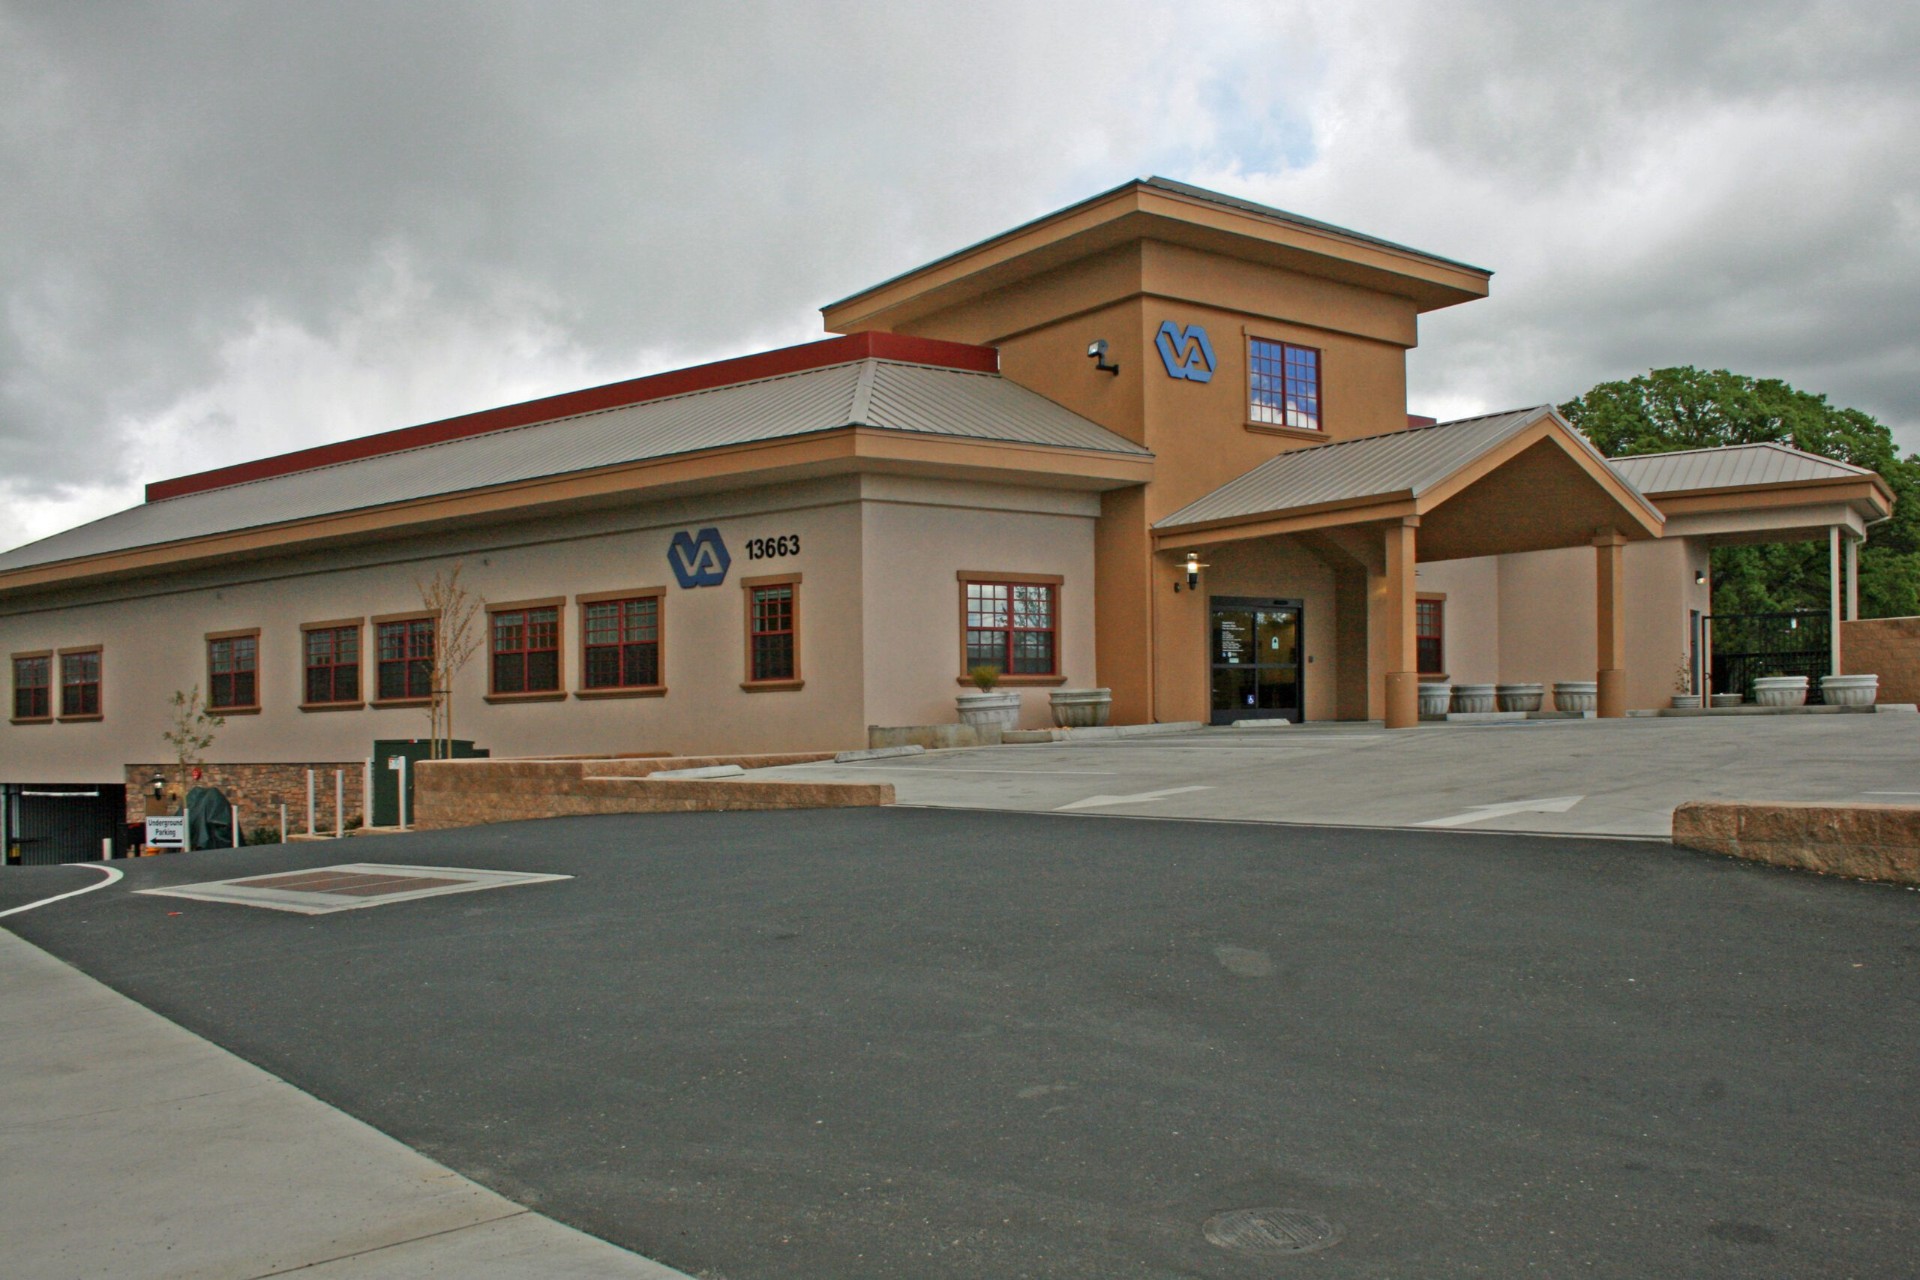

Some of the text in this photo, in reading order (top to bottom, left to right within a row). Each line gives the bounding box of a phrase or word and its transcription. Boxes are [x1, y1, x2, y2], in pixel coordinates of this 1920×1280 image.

[1154, 320, 1217, 384] VA
[667, 527, 731, 590] VA
[745, 534, 800, 560] 13663
[148, 819, 183, 827] Underground
[155, 829, 176, 837] Parking
